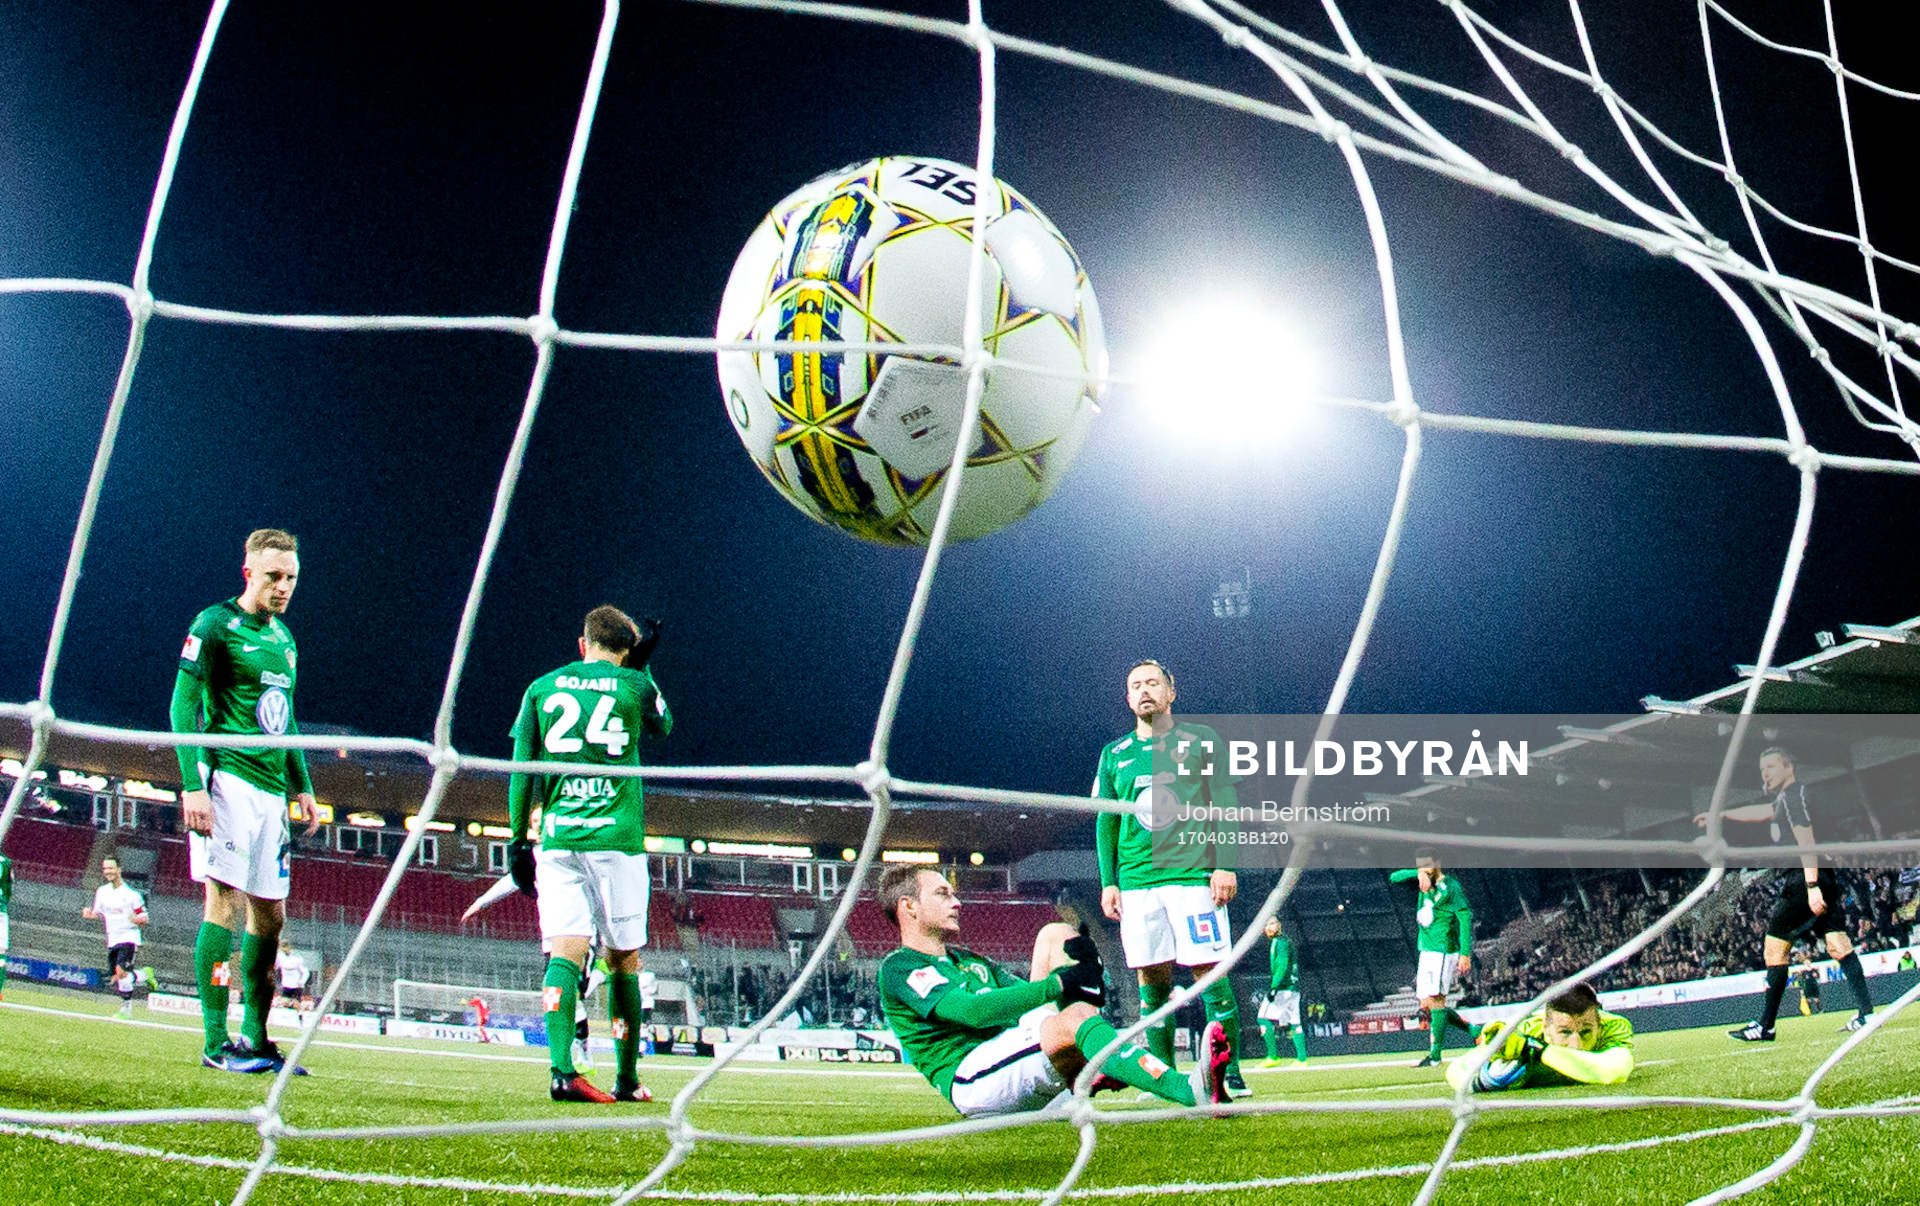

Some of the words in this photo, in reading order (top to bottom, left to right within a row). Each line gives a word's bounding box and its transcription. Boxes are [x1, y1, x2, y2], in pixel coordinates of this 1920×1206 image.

[901, 405, 931, 425] FIFA
[555, 675, 617, 692] GOJANI
[543, 692, 629, 756] 24
[561, 777, 616, 801] AQUA
